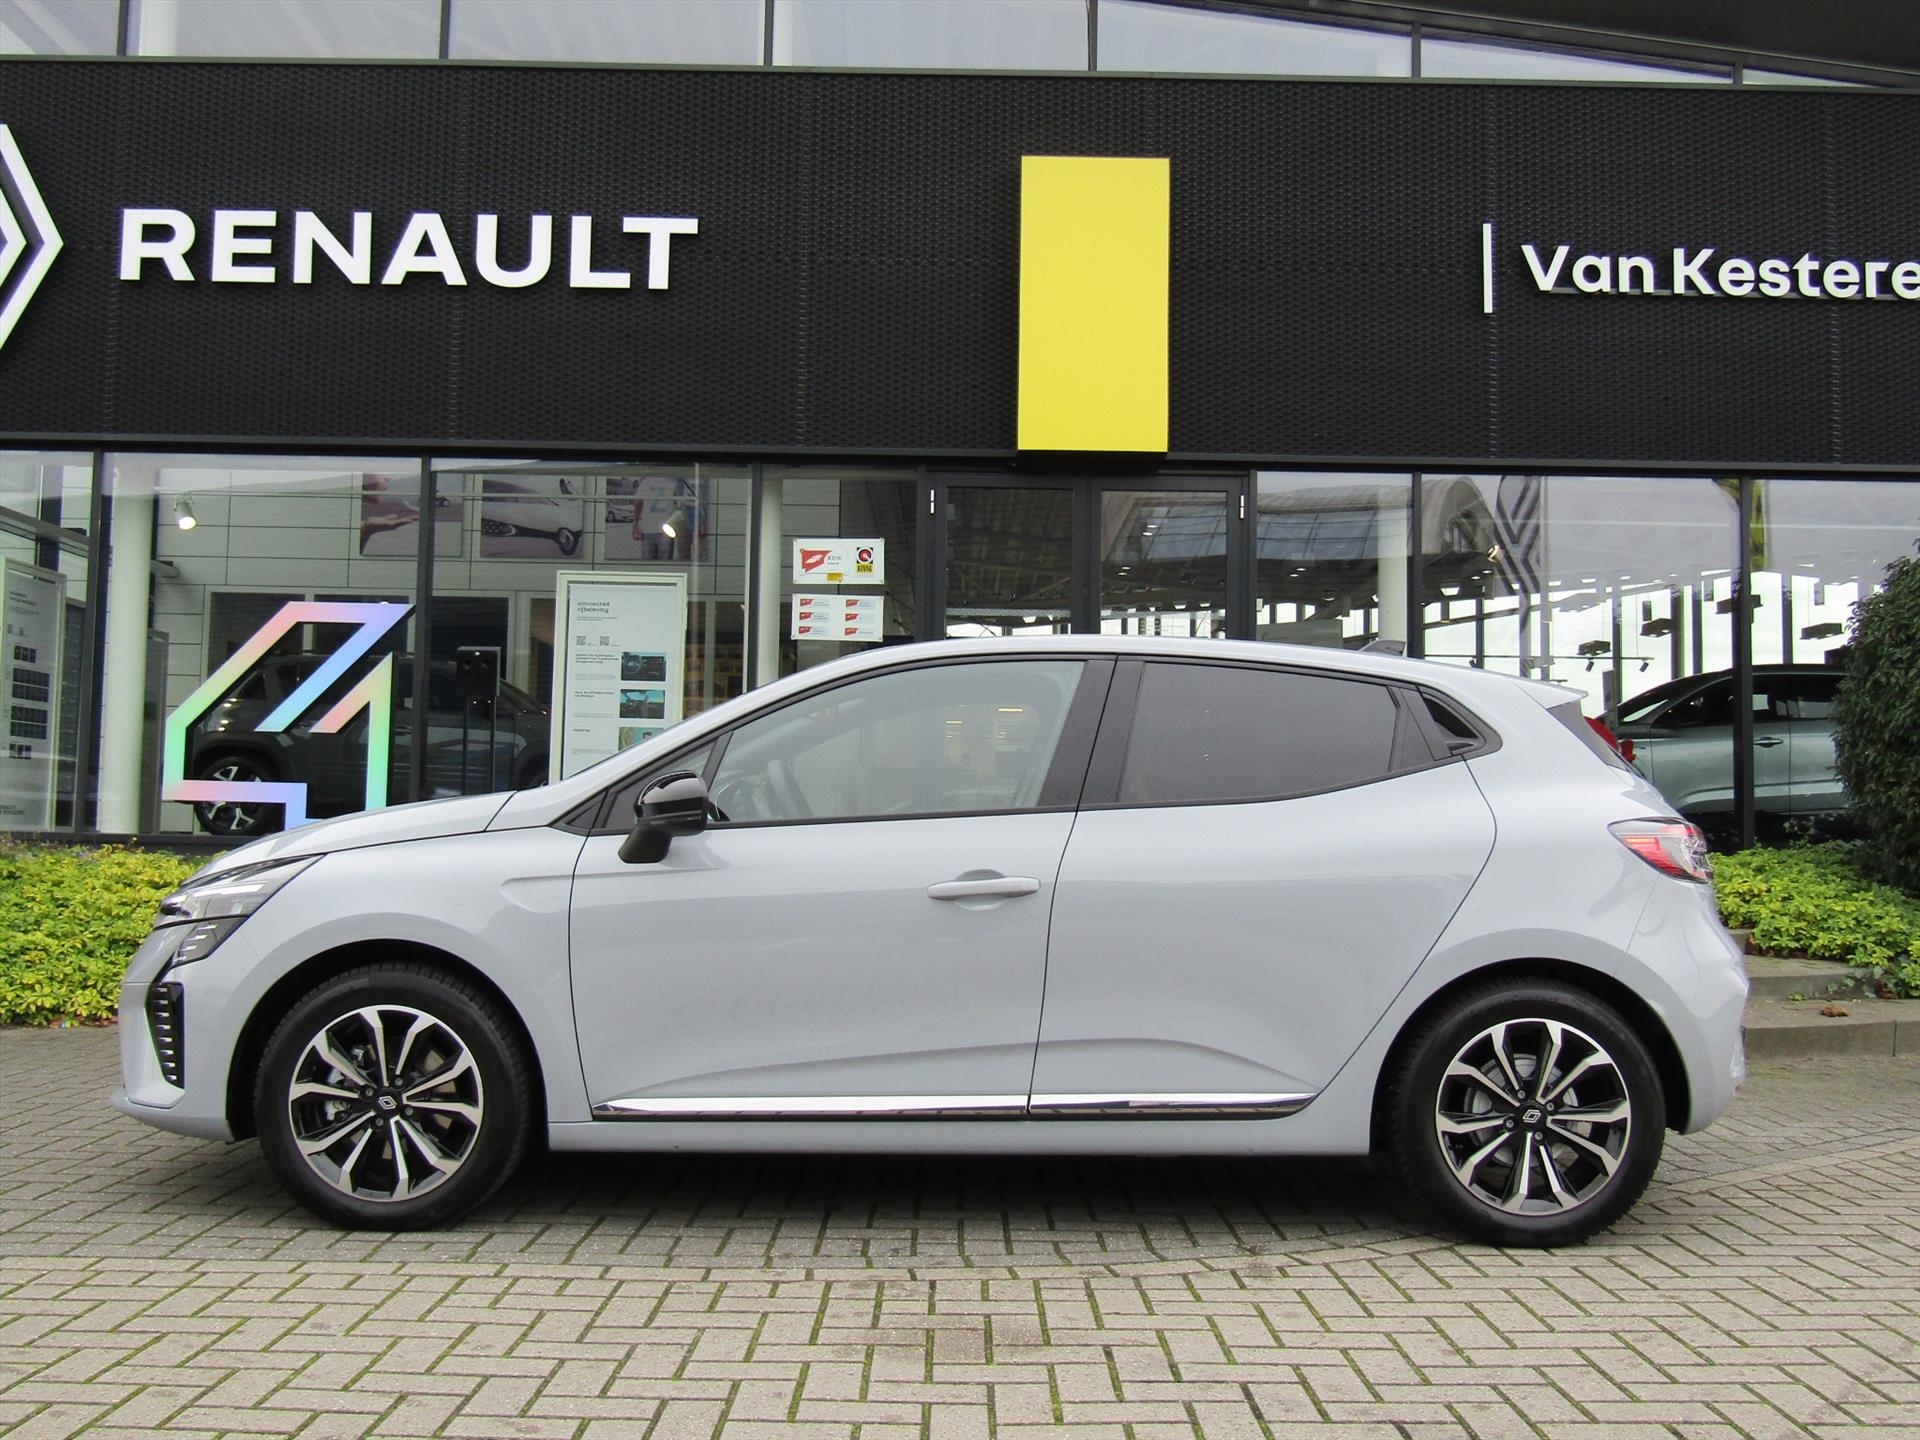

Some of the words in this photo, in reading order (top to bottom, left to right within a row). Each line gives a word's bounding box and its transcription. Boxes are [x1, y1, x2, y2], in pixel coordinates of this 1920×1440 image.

[118, 207, 699, 290] RENAULT
[1521, 244, 1655, 294] Van
[1672, 247, 1920, 299] Kestere
